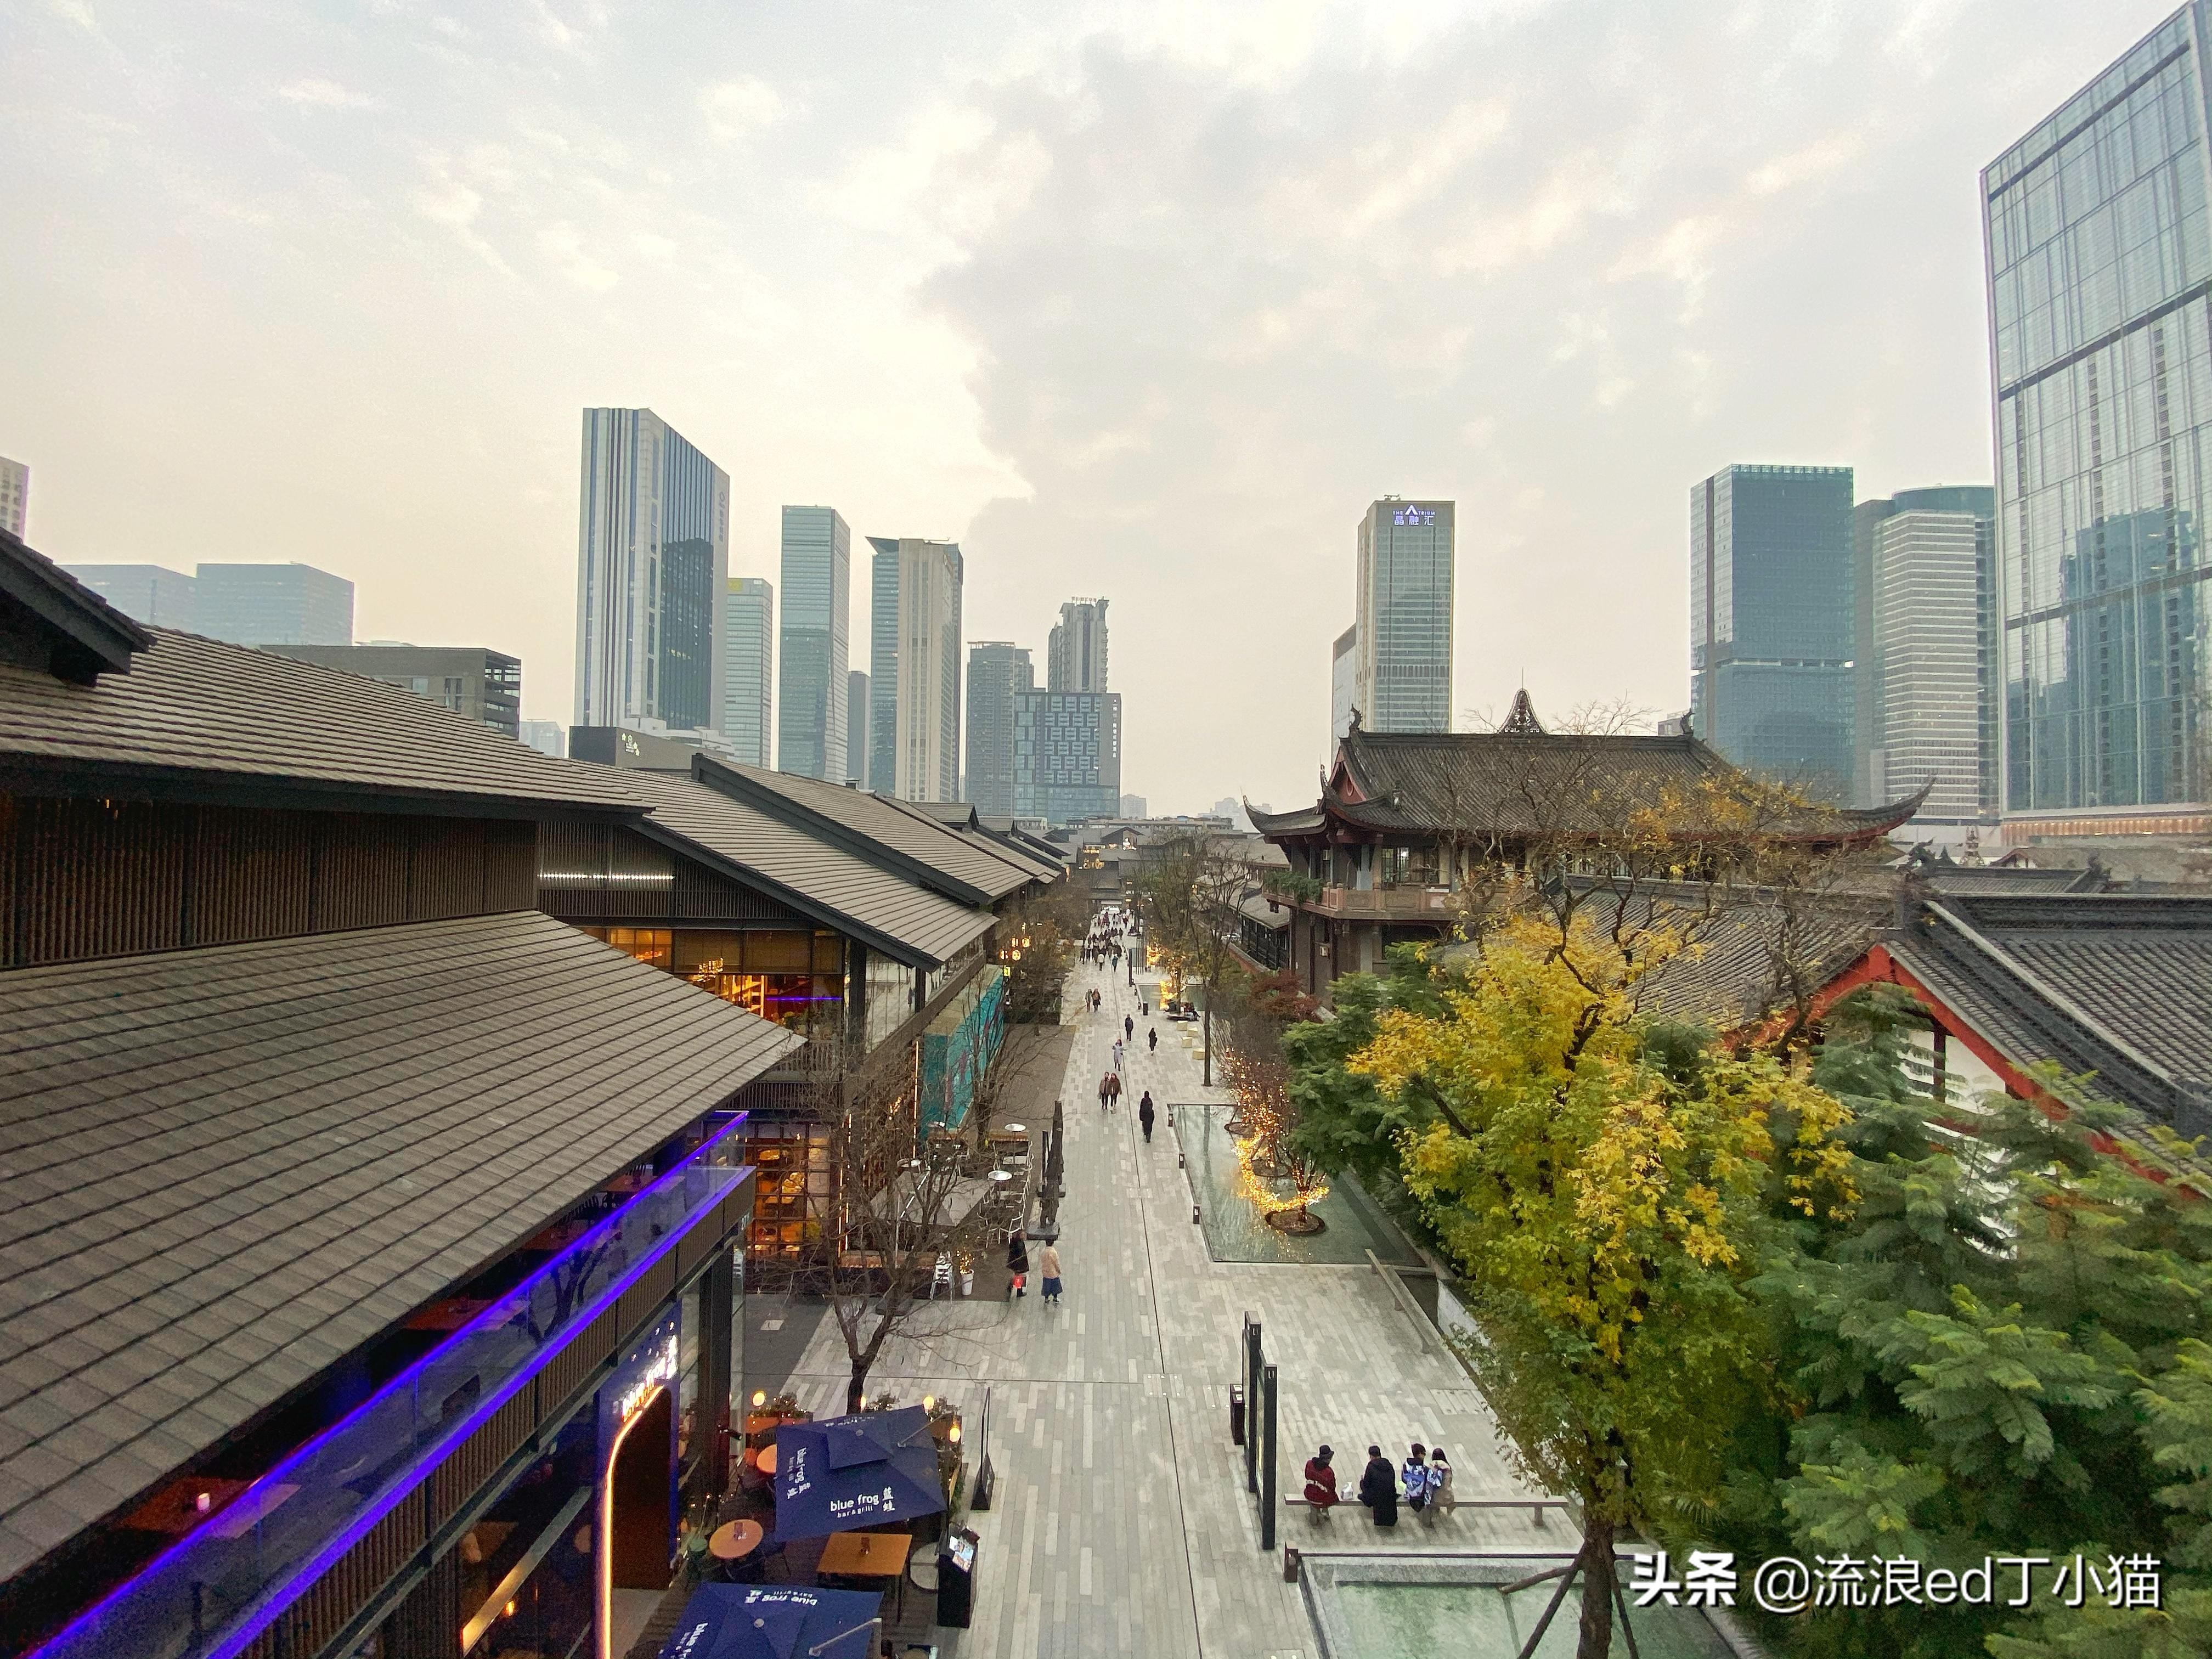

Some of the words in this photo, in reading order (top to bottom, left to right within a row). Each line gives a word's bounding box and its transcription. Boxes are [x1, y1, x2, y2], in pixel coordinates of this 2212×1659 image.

[1394, 515, 1434, 526] 晶融汇
[830, 1500, 854, 1511] blue
[857, 1494, 879, 1505] frog
